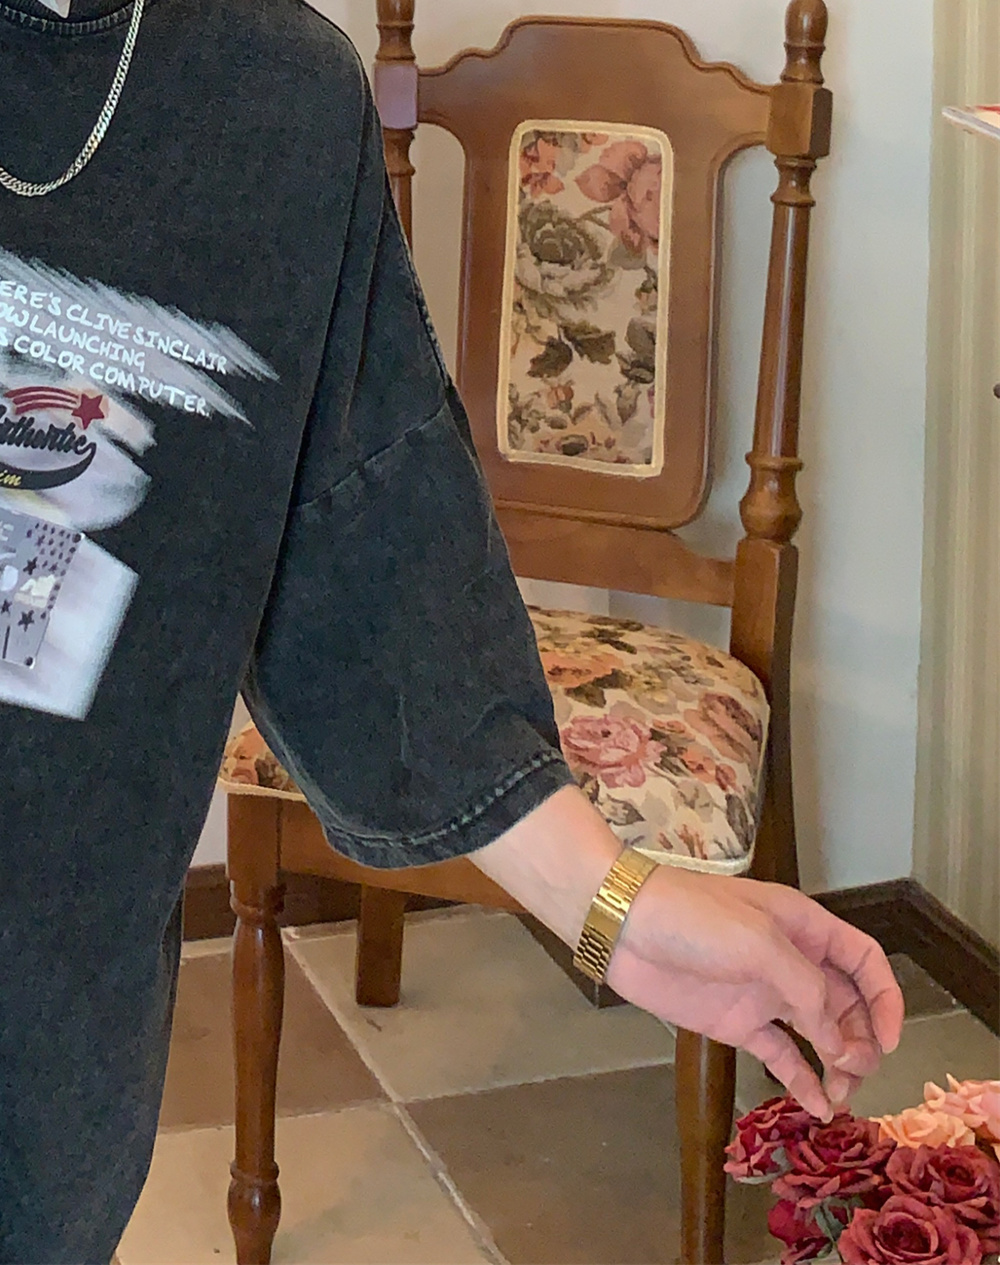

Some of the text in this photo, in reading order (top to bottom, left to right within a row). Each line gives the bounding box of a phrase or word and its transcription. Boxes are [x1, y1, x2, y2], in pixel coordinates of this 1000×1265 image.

[29, 314, 145, 373] LAUNCHING
[66, 304, 132, 339] CLIVE
[133, 326, 227, 375] SINCLAIR
[14, 335, 85, 375] COLOR
[89, 362, 210, 417] COMPUTER.
